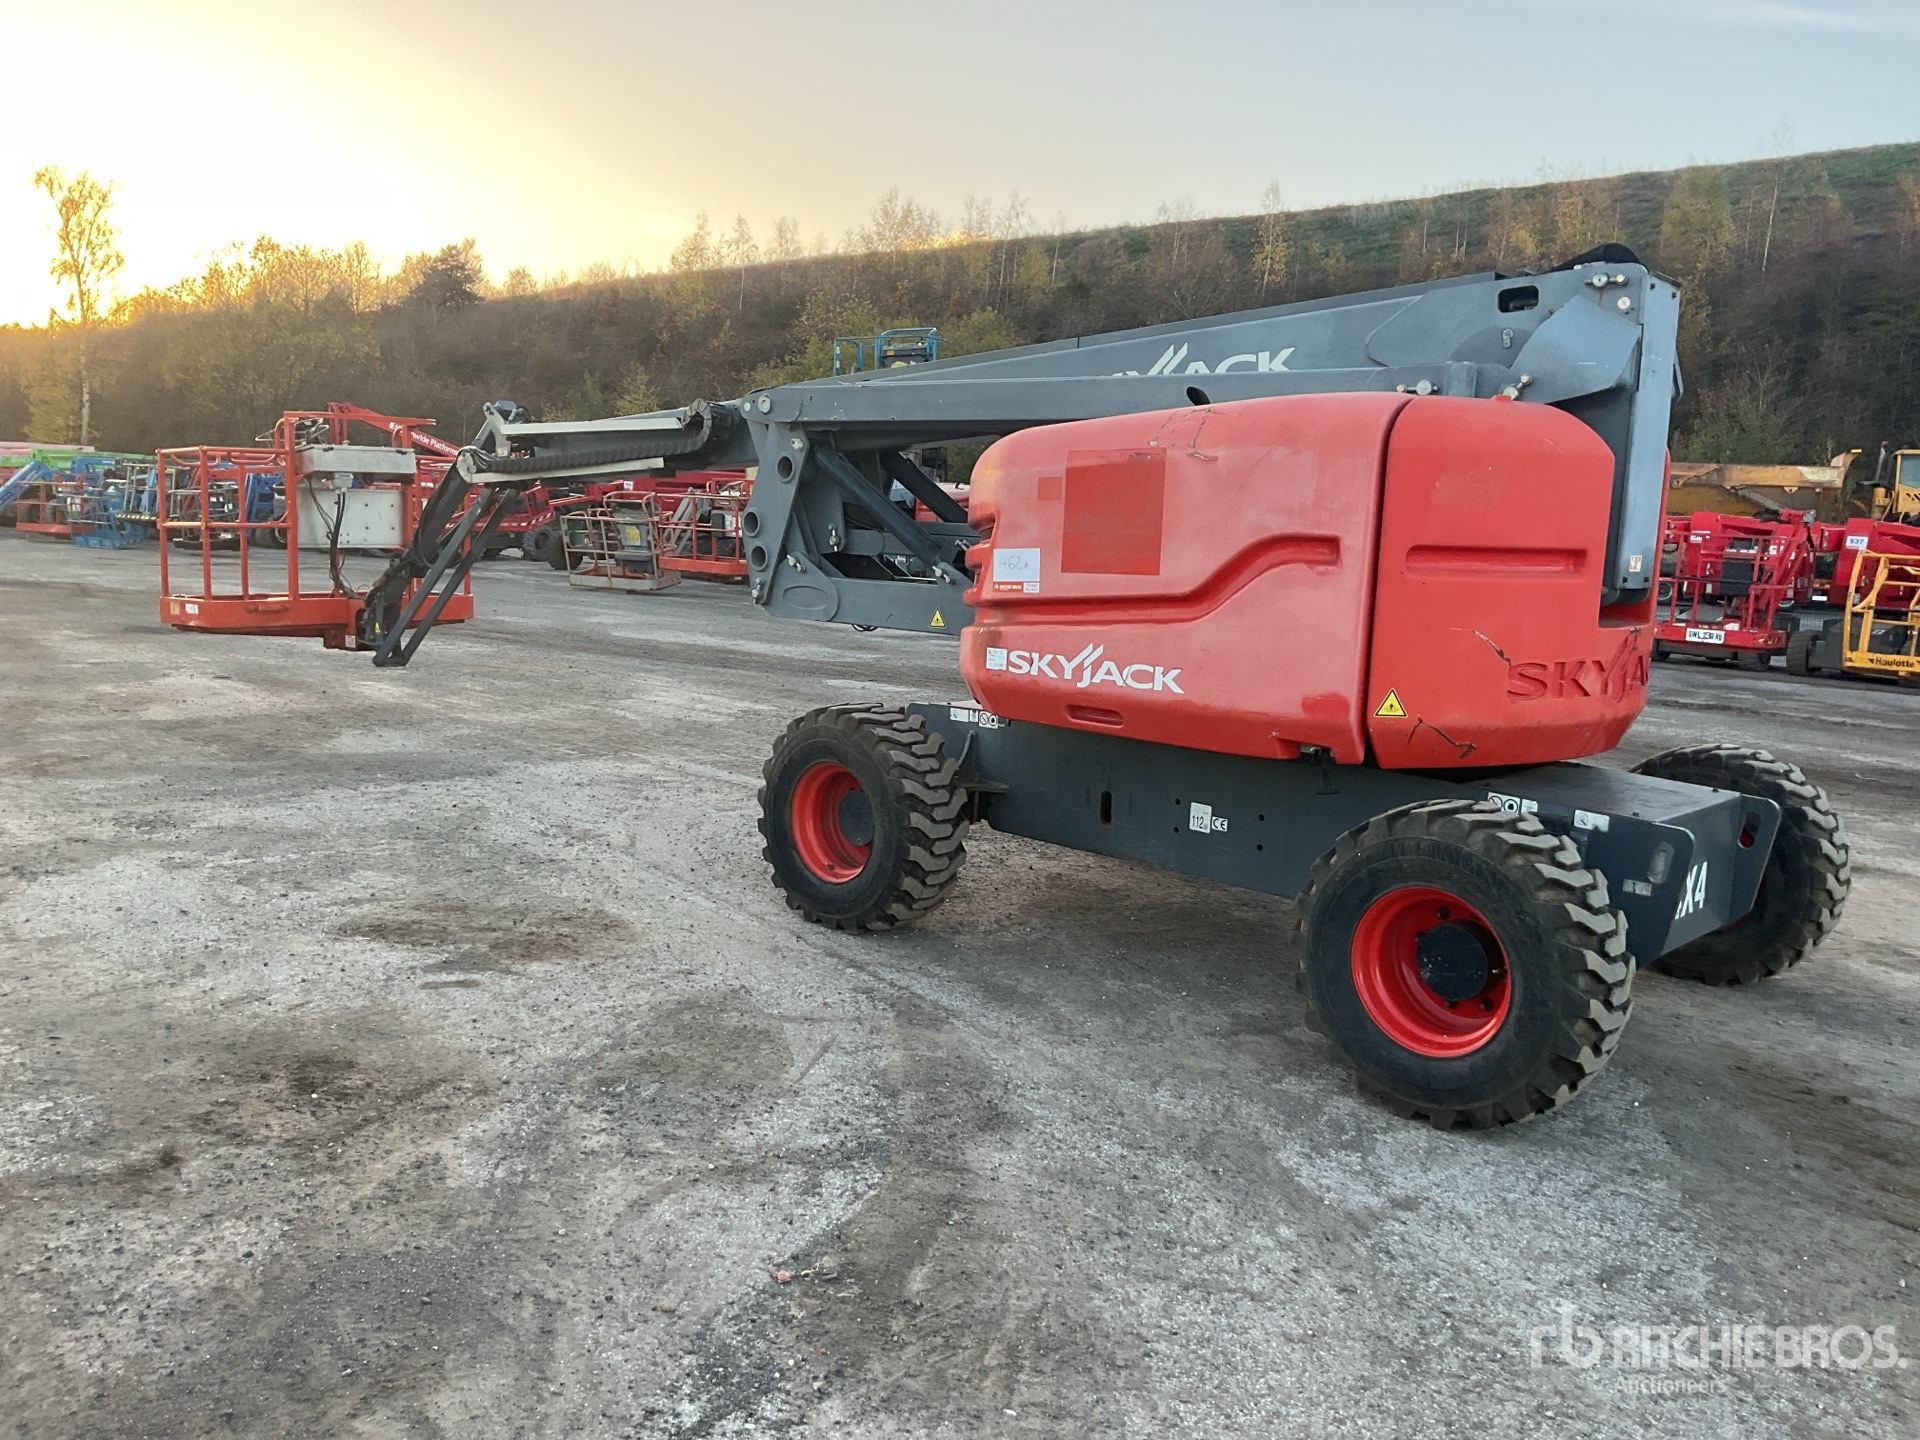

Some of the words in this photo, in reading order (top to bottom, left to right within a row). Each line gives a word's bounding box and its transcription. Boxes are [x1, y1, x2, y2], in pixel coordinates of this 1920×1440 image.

[1688, 630, 1701, 639] SWL
[1008, 643, 1184, 694] SKYJACK
[1507, 627, 1649, 704] SKYJA
[1875, 657, 1915, 668] Haulotte
